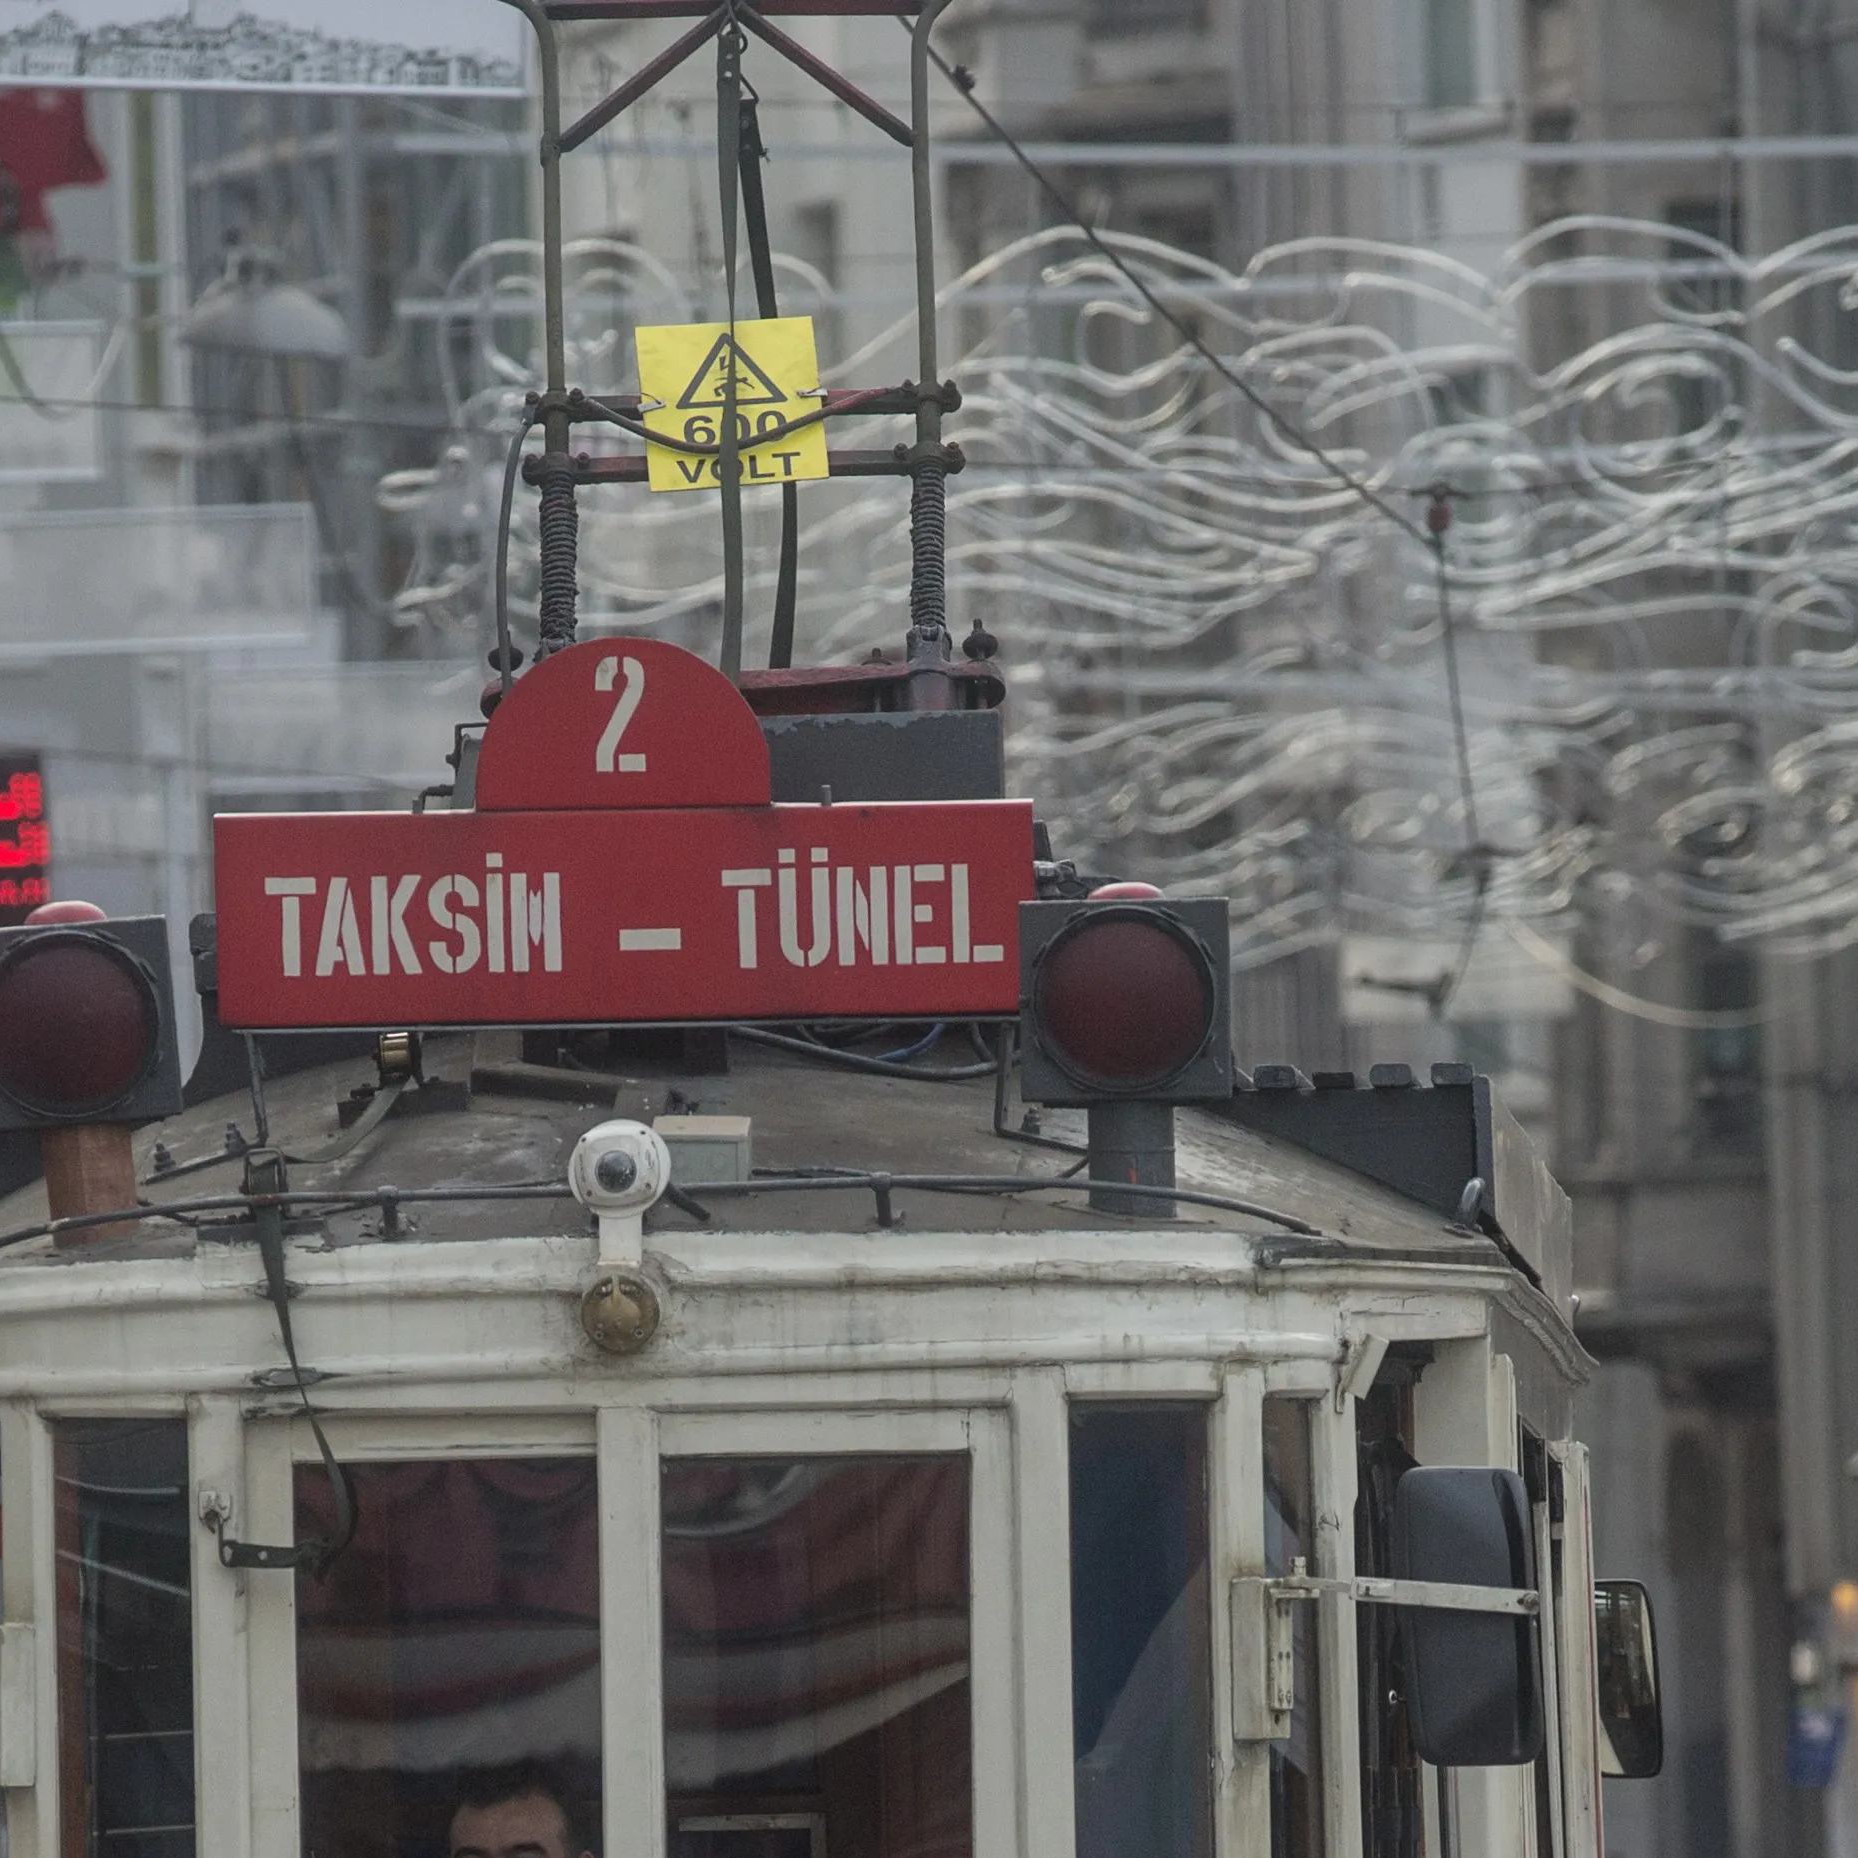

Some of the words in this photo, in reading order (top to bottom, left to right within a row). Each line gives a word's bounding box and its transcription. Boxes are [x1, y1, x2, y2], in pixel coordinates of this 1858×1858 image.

[594, 656, 647, 773] 2
[264, 852, 563, 977] TAKSİM
[721, 847, 1004, 969] TÜNEL
